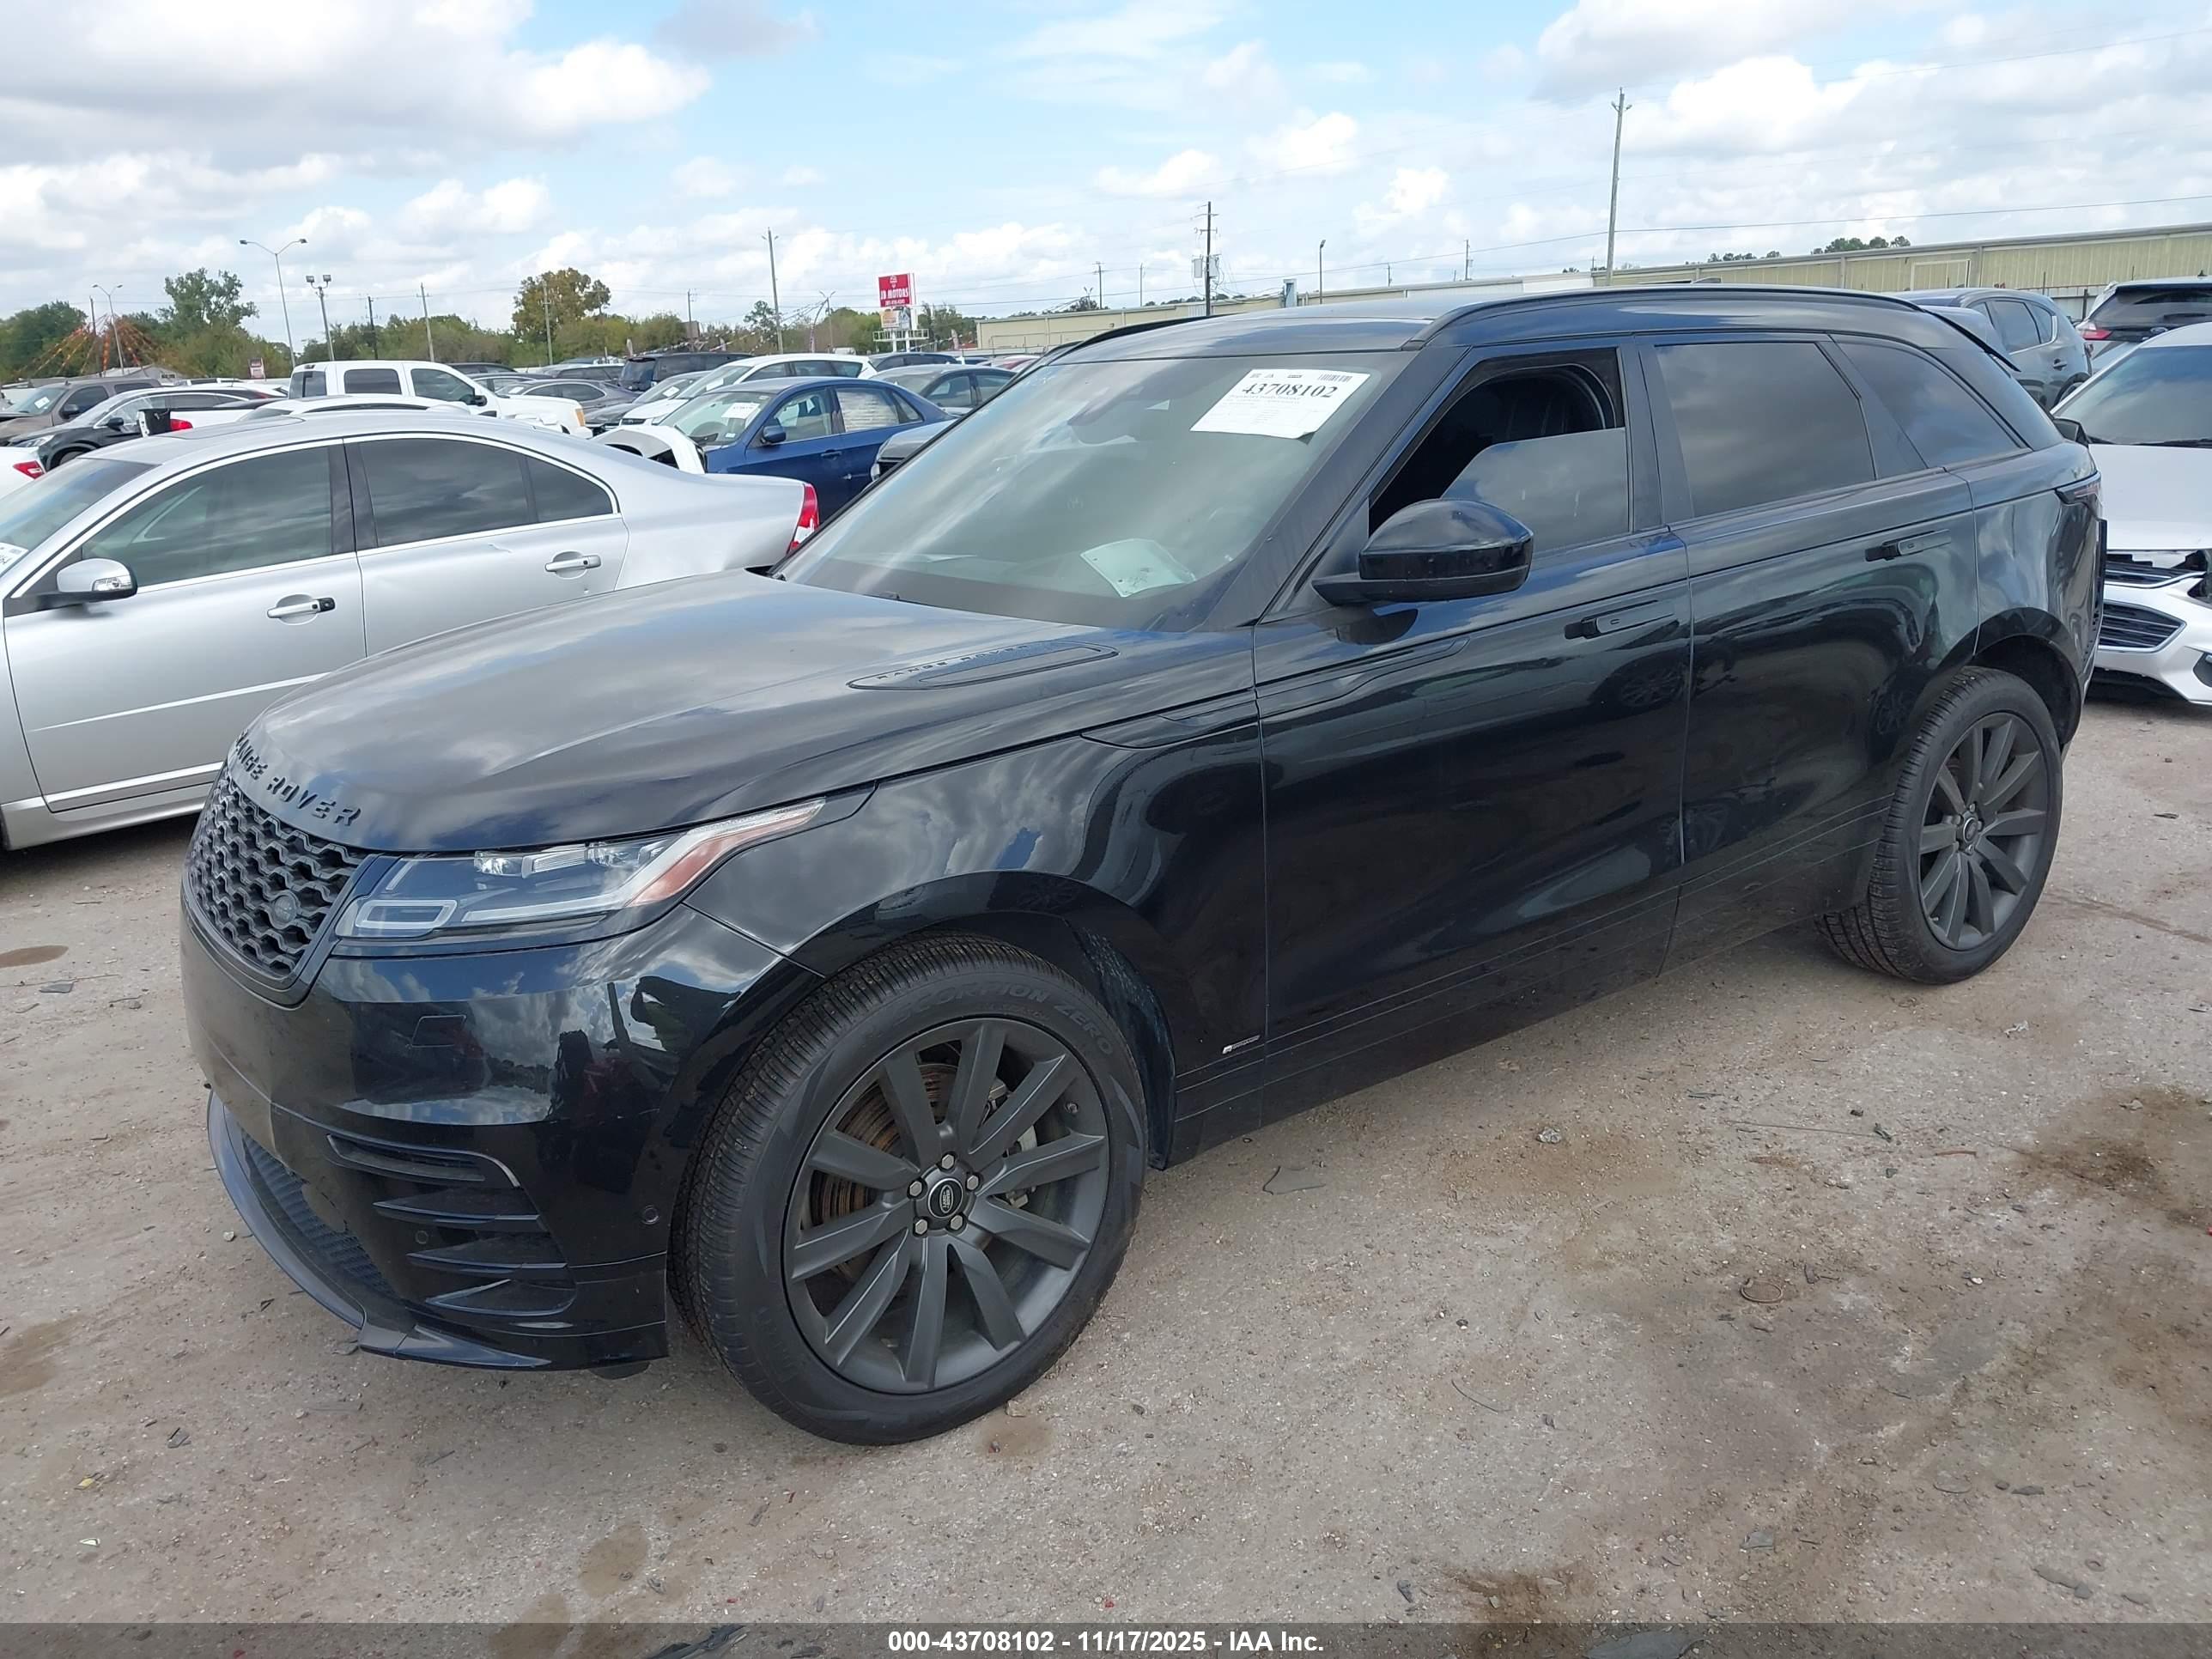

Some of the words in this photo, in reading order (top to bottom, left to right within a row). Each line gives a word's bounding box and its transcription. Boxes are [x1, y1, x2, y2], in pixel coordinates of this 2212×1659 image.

[888, 288, 908, 298] MOTORS
[1242, 383, 1338, 398] 43708102
[877, 661, 947, 680] RANGE
[266, 777, 362, 826] ROVER
[1052, 1003, 1114, 1055] ZERO
